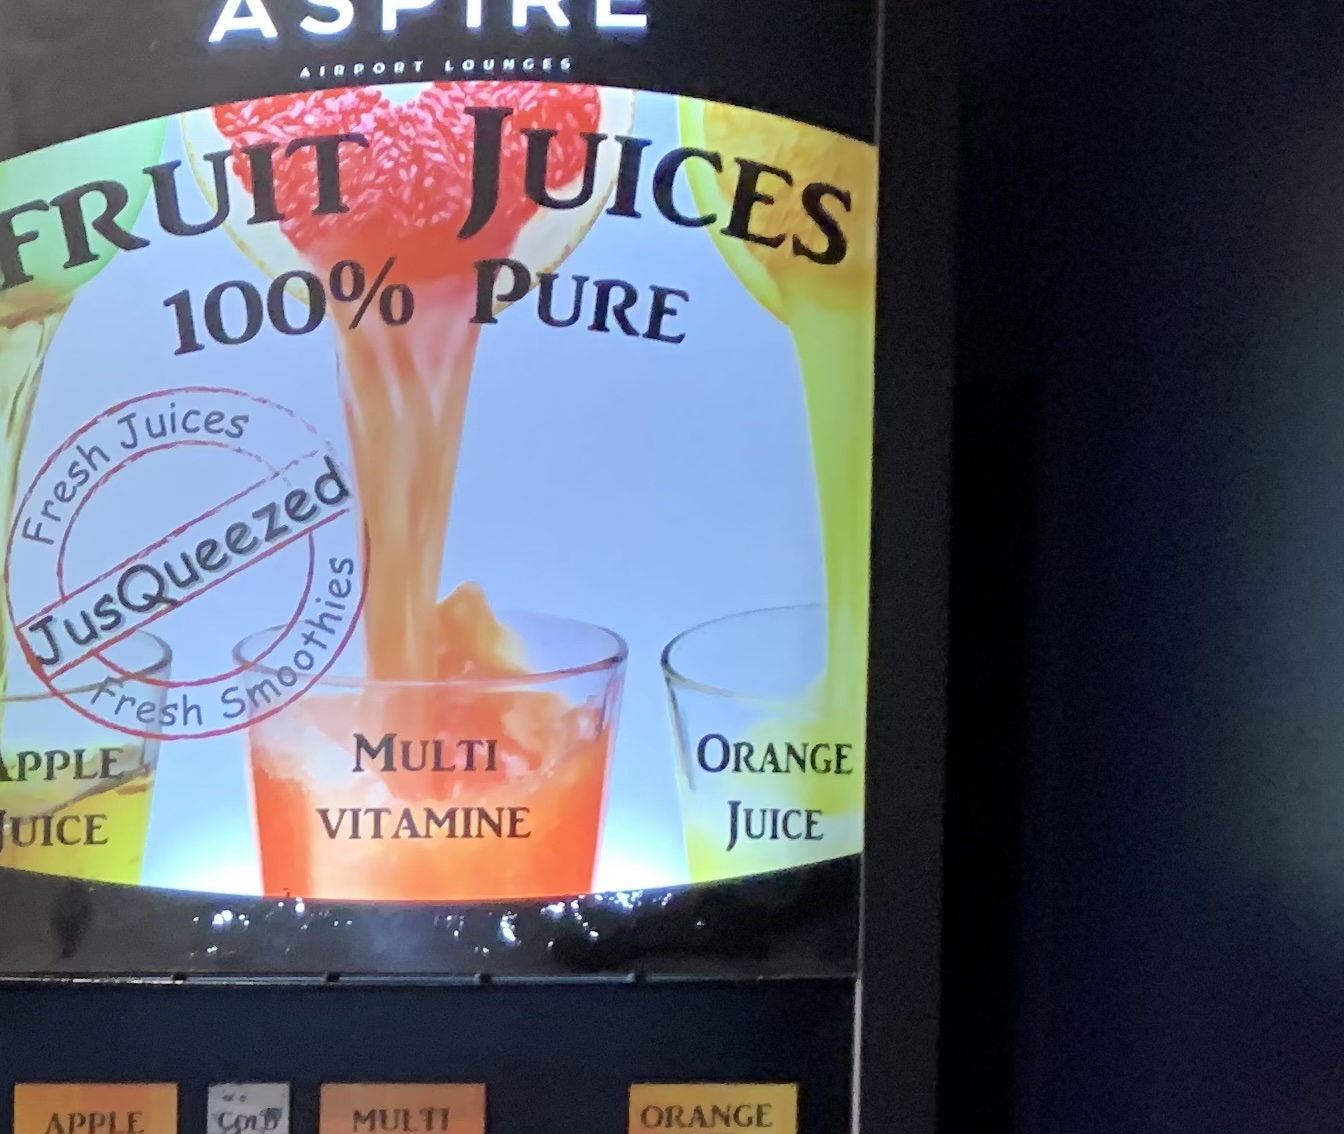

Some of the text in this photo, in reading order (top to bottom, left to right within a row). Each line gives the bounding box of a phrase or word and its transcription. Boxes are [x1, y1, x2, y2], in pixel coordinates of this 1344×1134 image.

[299, 57, 574, 78] AIRPORT LOUNGES
[457, 106, 853, 267] JUICES
[162, 256, 690, 357] 100% PURE
[21, 401, 250, 546] Fresh Juices
[27, 455, 351, 667] JusQueezed
[90, 555, 355, 727] Fresh Smoothies
[352, 731, 500, 774] MULTI
[695, 731, 854, 777] ORANGE
[315, 806, 533, 841] VITAMINE
[726, 799, 826, 843] JUICE
[352, 1107, 451, 1134] MULTI
[640, 1103, 775, 1130] ORANGE
